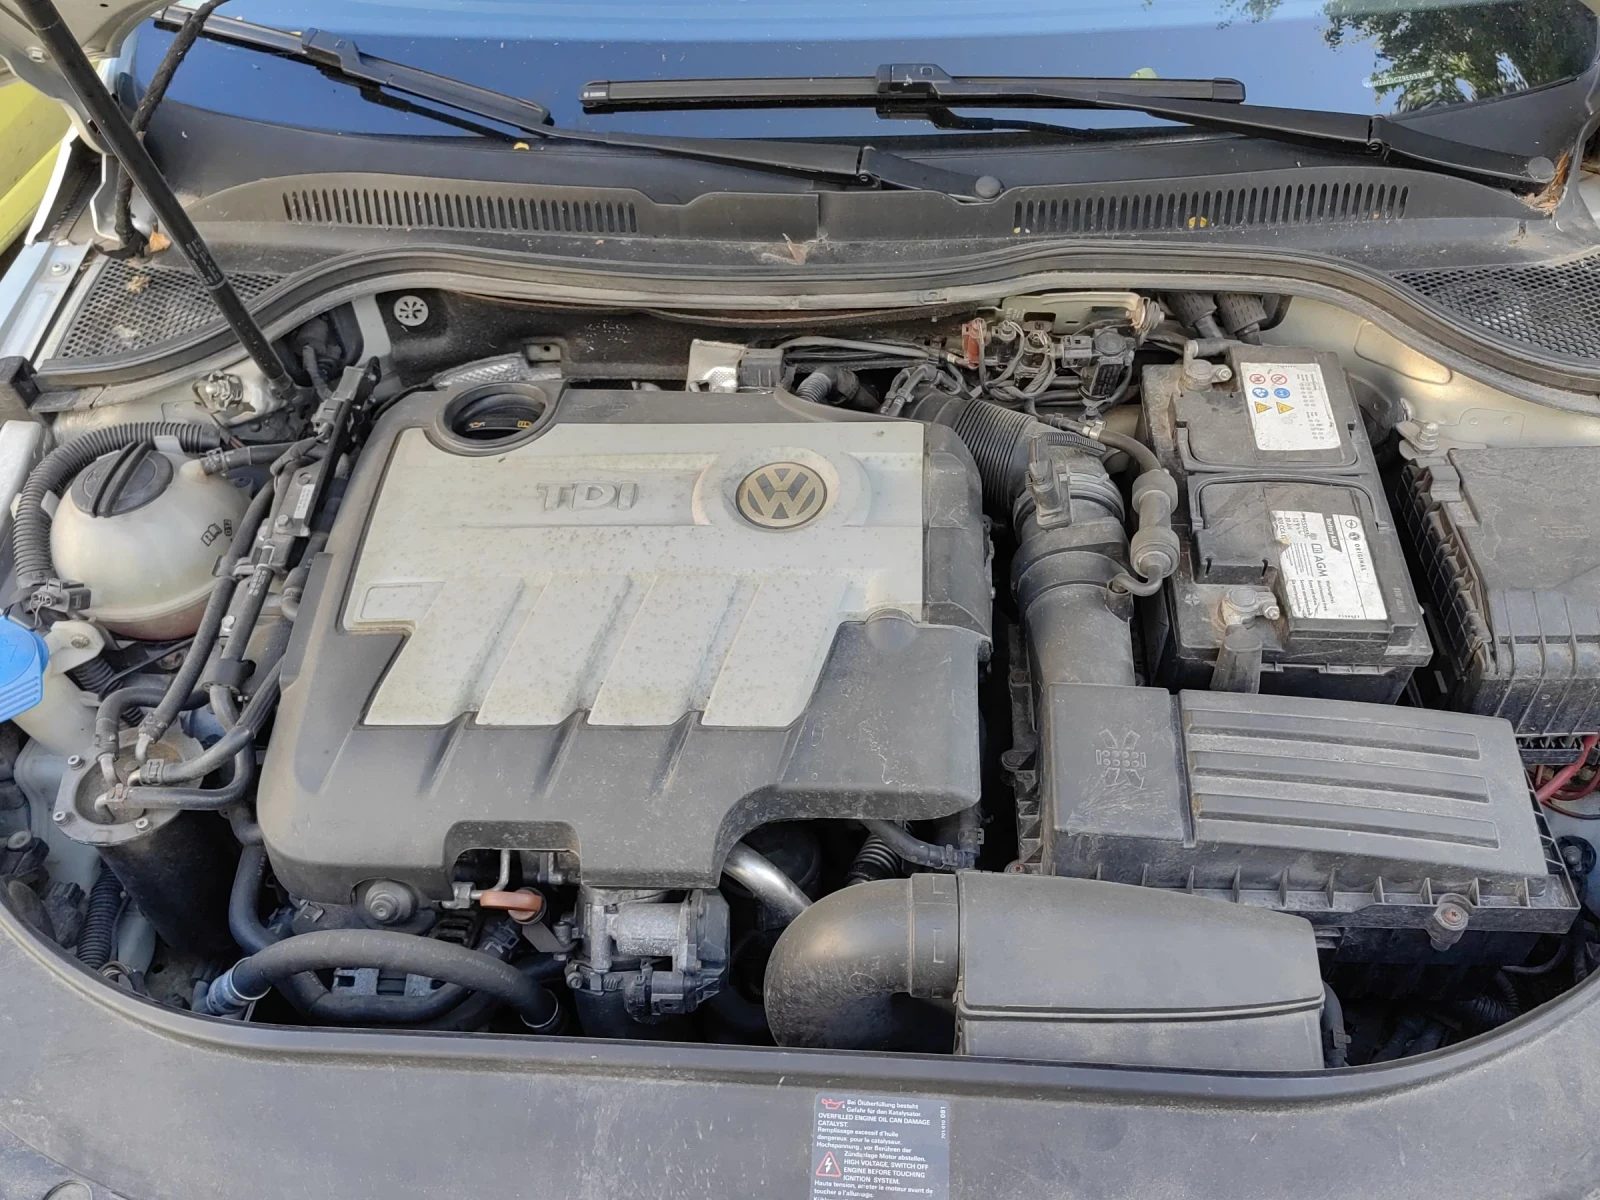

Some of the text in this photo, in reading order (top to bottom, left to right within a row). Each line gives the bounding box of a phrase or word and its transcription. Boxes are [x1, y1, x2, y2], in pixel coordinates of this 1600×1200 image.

[537, 481, 638, 511] TDI
[1314, 556, 1328, 577] AGM
[1354, 543, 1367, 571] ORIGINAL
[817, 1127, 854, 1135] Remplissage
[879, 1152, 896, 1160] Motor
